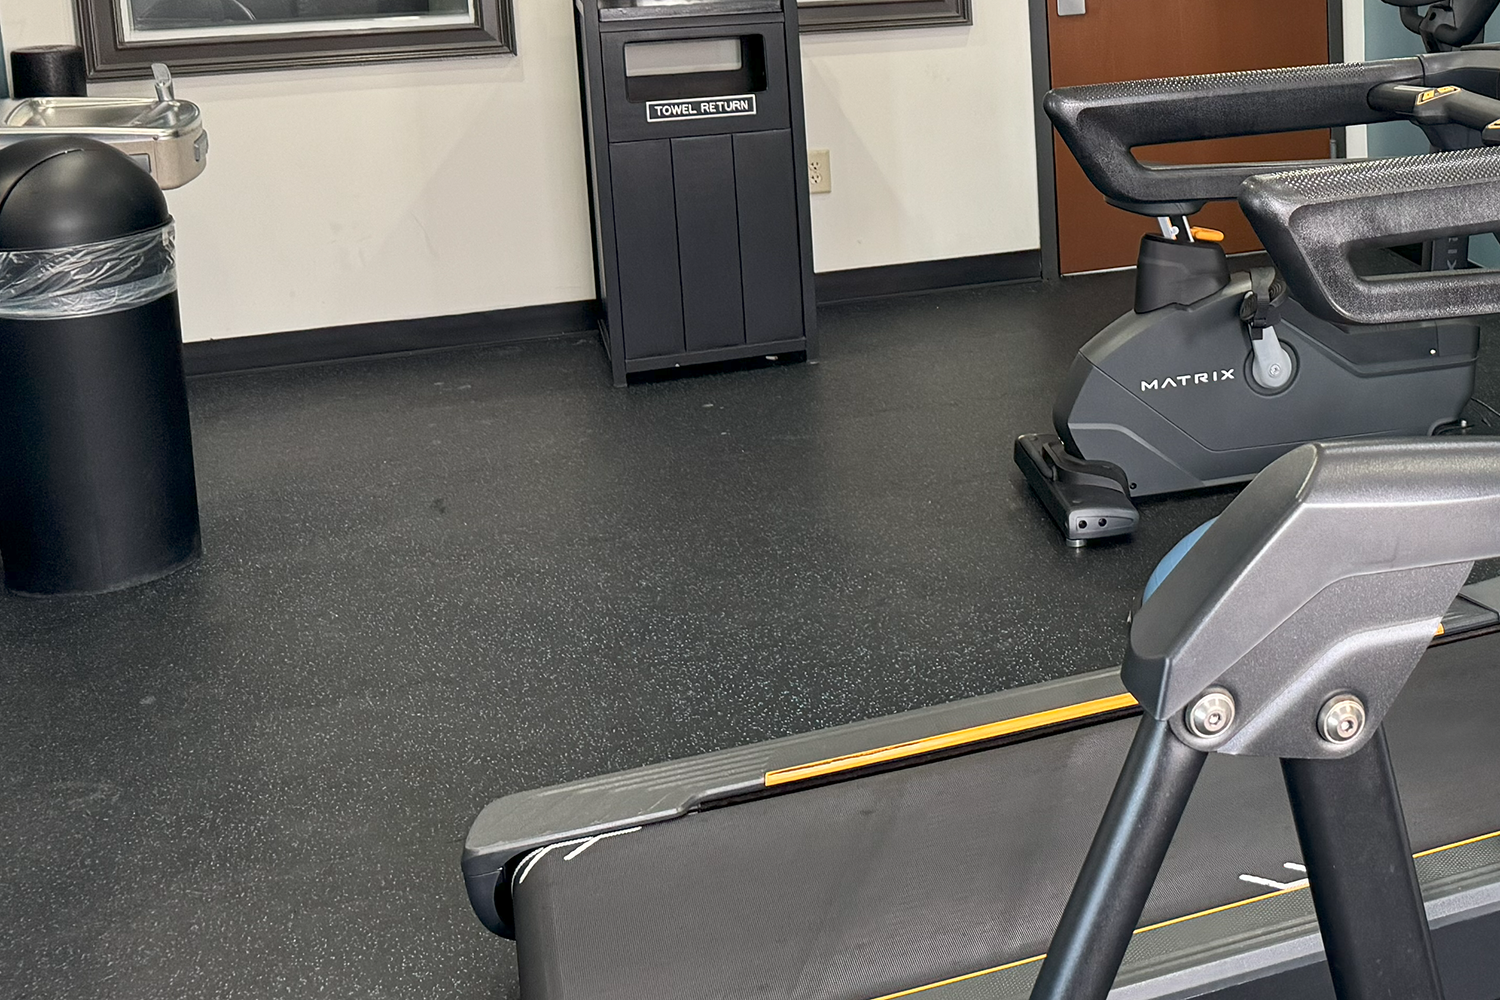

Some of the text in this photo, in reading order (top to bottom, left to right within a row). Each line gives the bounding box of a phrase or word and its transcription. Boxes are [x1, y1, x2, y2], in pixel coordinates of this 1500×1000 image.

[654, 100, 748, 117] TOWEL RETURN
[1140, 368, 1235, 392] MATRIX
